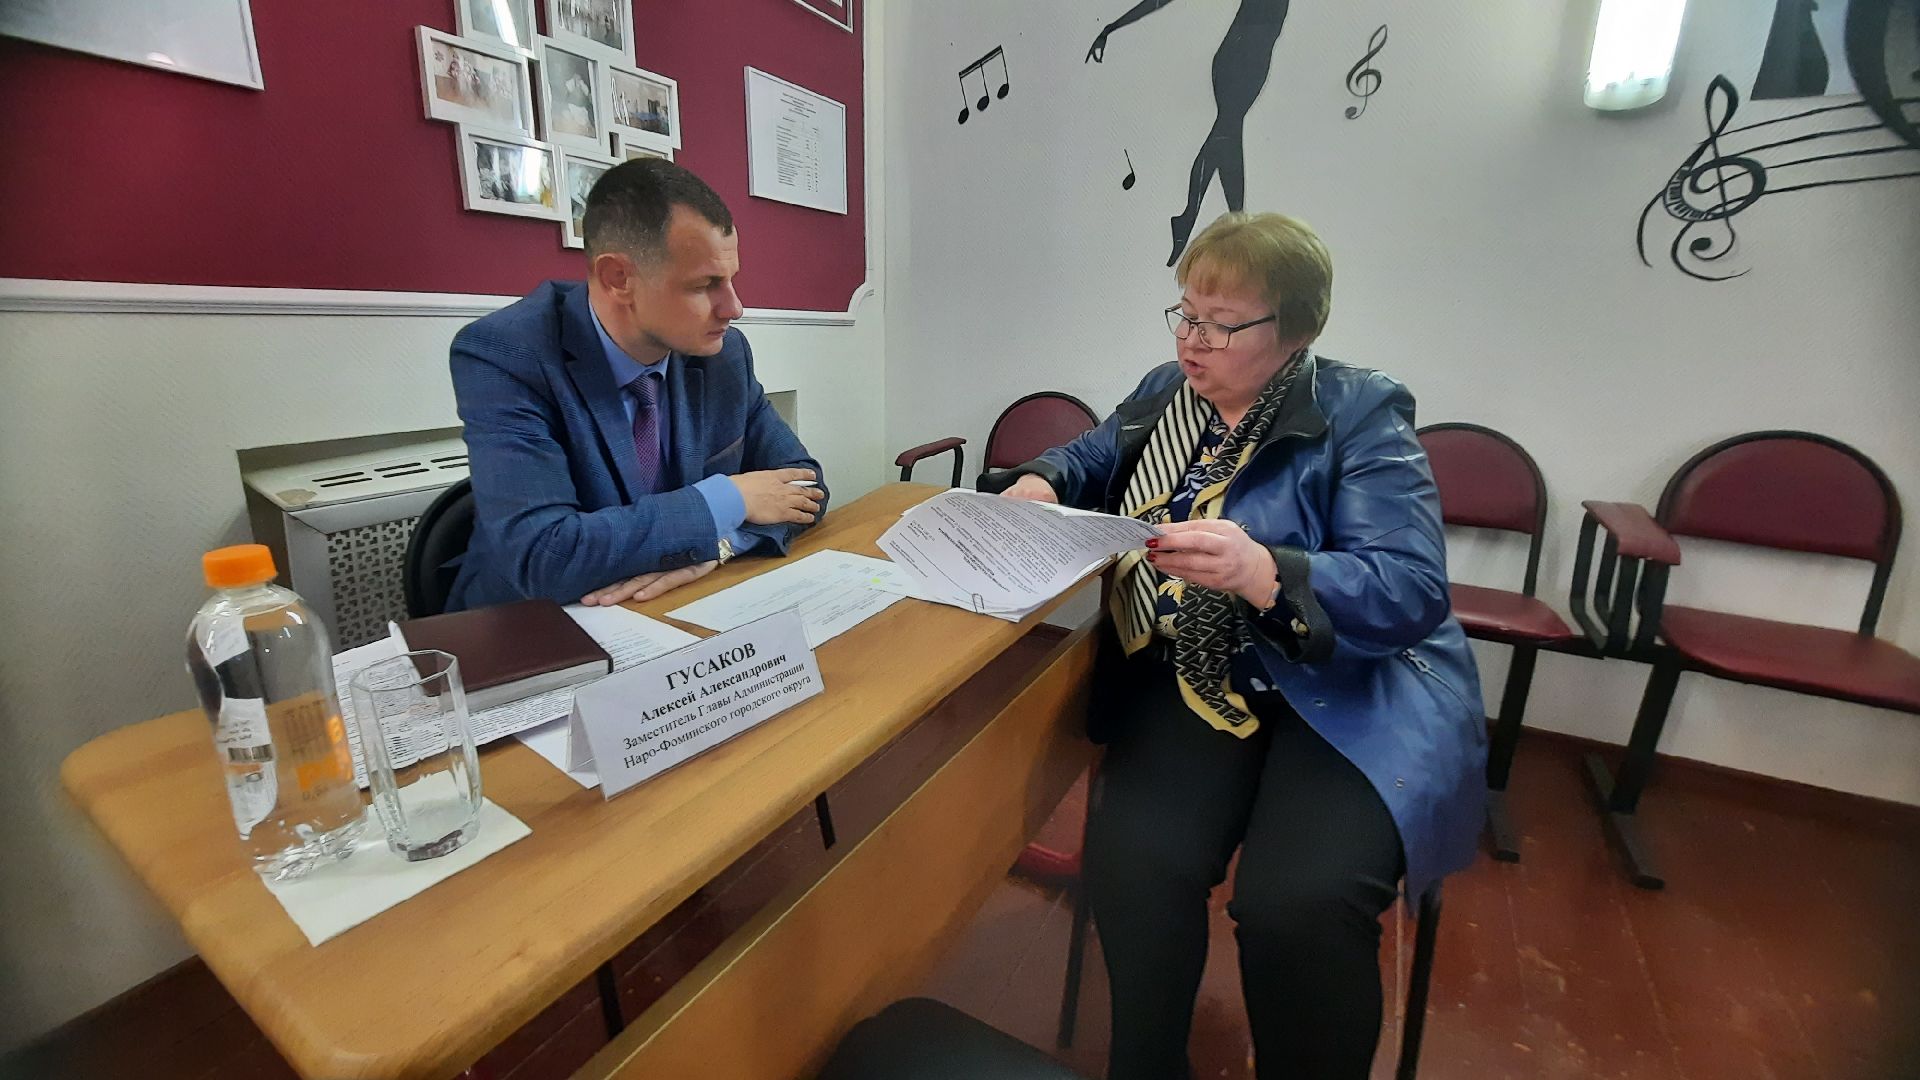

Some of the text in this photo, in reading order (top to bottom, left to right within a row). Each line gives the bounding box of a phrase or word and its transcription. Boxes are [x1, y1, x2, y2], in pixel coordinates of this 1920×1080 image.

[641, 654, 786, 724] Алексей Александрович
[665, 643, 756, 690] ГУСАКОВ
[623, 663, 805, 749] Заместитель Главы Администрации
[624, 676, 811, 768] Наро-Фоминского городского округа
